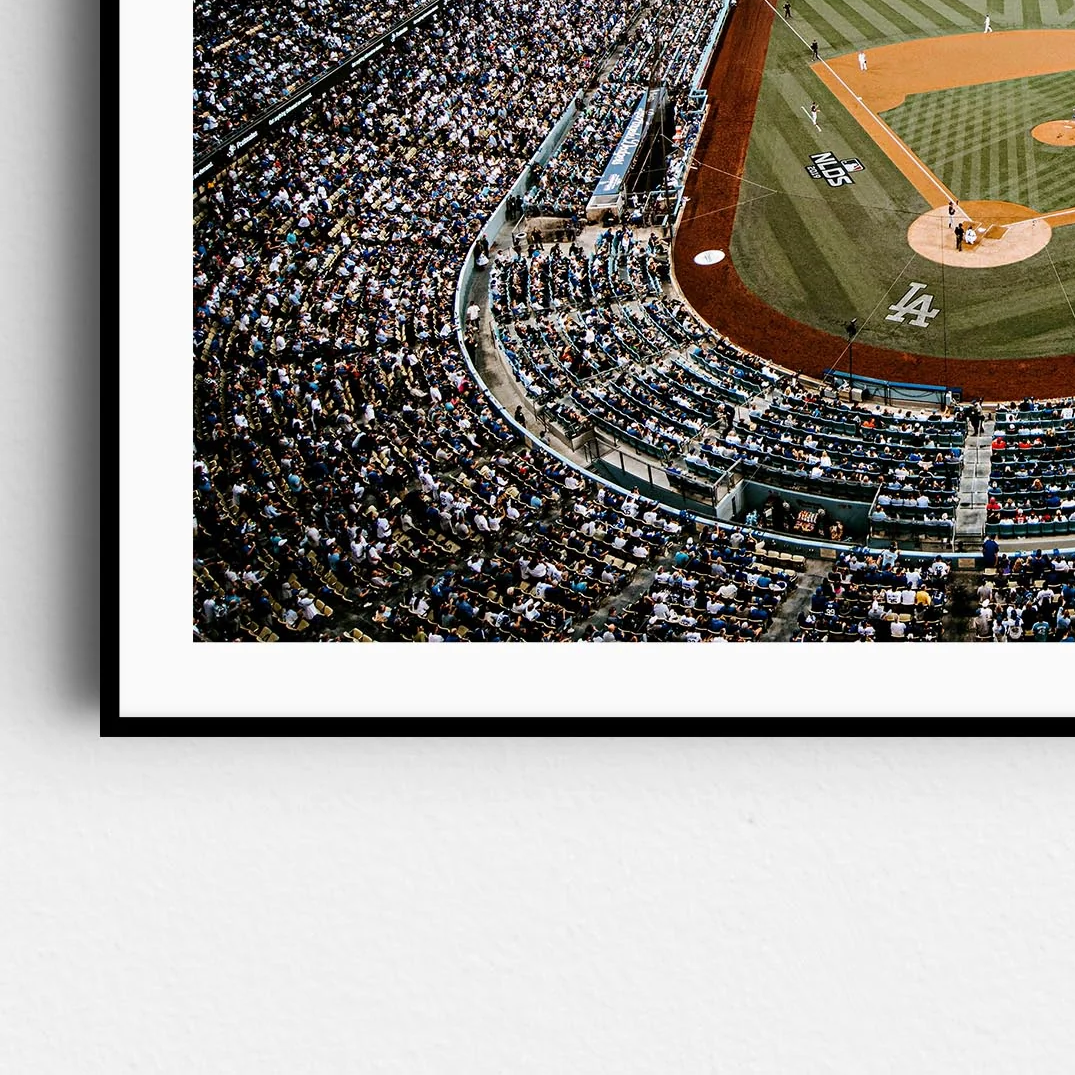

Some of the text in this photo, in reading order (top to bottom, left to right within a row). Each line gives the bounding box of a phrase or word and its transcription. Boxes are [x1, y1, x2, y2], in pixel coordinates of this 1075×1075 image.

[807, 166, 821, 179] 2019
[810, 152, 852, 187] NLDS
[885, 281, 941, 327] LA
